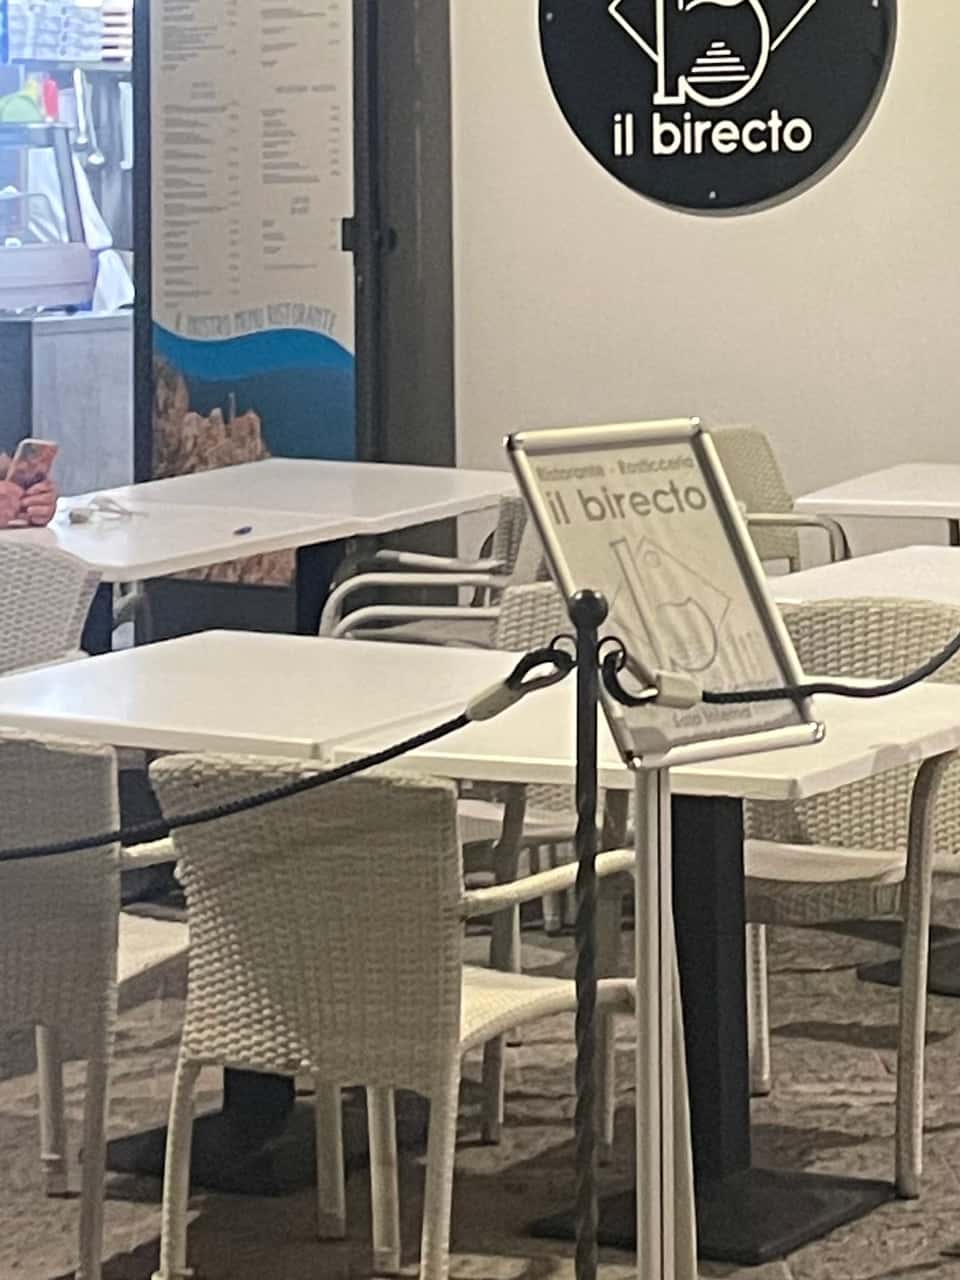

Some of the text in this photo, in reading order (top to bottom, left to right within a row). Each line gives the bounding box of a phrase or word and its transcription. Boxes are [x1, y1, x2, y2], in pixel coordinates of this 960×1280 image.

[613, 109, 813, 156] il birecto
[545, 479, 707, 526] il birecto
